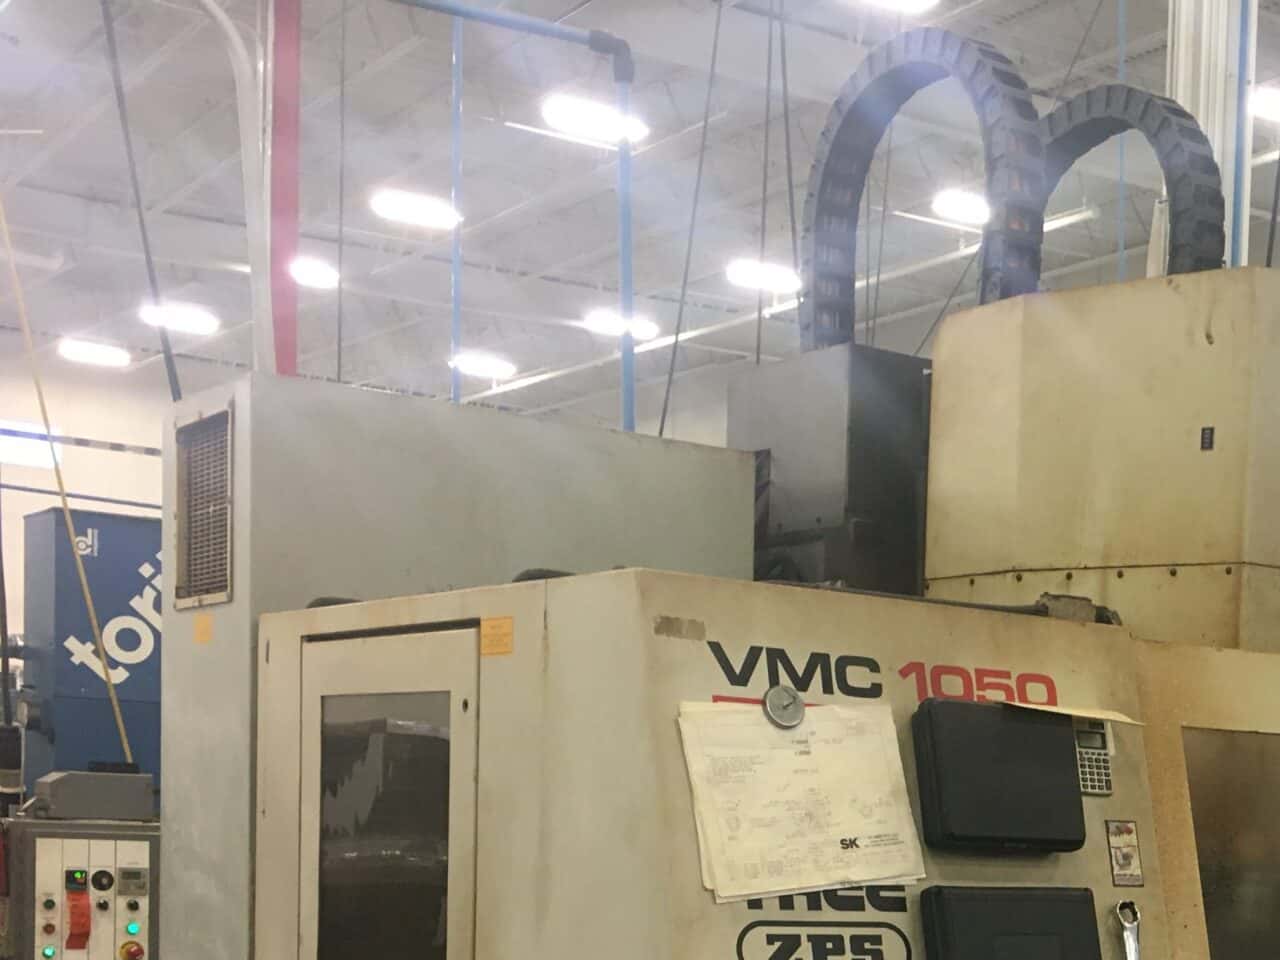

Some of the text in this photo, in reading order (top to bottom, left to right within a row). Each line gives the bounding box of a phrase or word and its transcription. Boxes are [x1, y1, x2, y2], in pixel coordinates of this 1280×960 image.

[706, 640, 1058, 707] VMC 1050
[839, 837, 860, 850] SK
